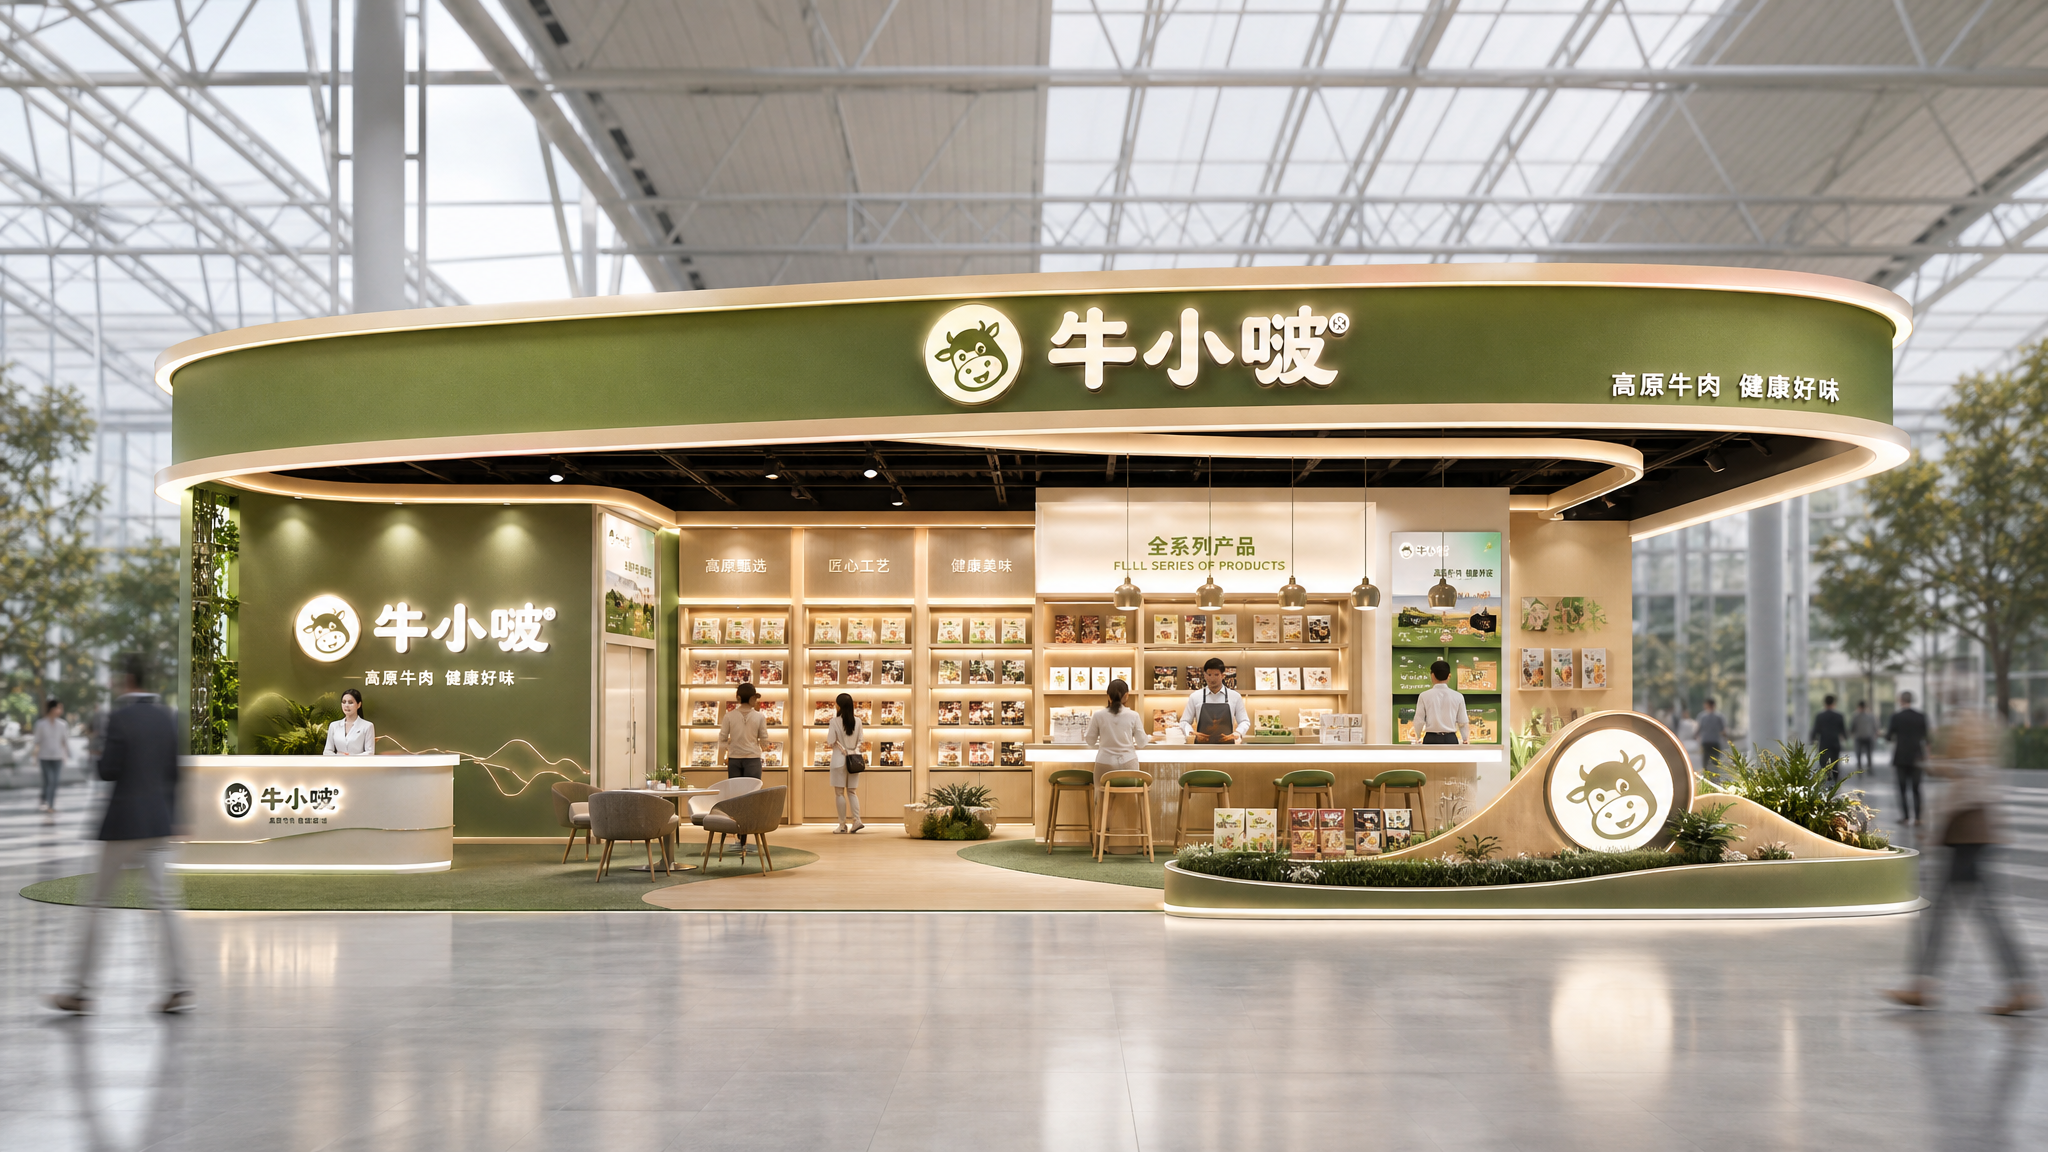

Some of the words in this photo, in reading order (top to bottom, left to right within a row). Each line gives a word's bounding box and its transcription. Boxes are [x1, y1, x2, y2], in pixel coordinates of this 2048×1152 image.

[1611, 372, 1720, 398] 高原牛肉
[1739, 374, 1840, 403] 健康好味
[1148, 536, 1256, 557] 全系列产品
[705, 558, 767, 573] 高原甄选
[828, 558, 890, 573] 匠心工艺
[951, 558, 1013, 573] 健康美味
[1151, 561, 1194, 570] SERIES
[1198, 561, 1215, 570] OF
[1219, 561, 1286, 570] PRODUCTS
[364, 670, 434, 686] 高原牛肉
[445, 670, 515, 686] 健康好味
